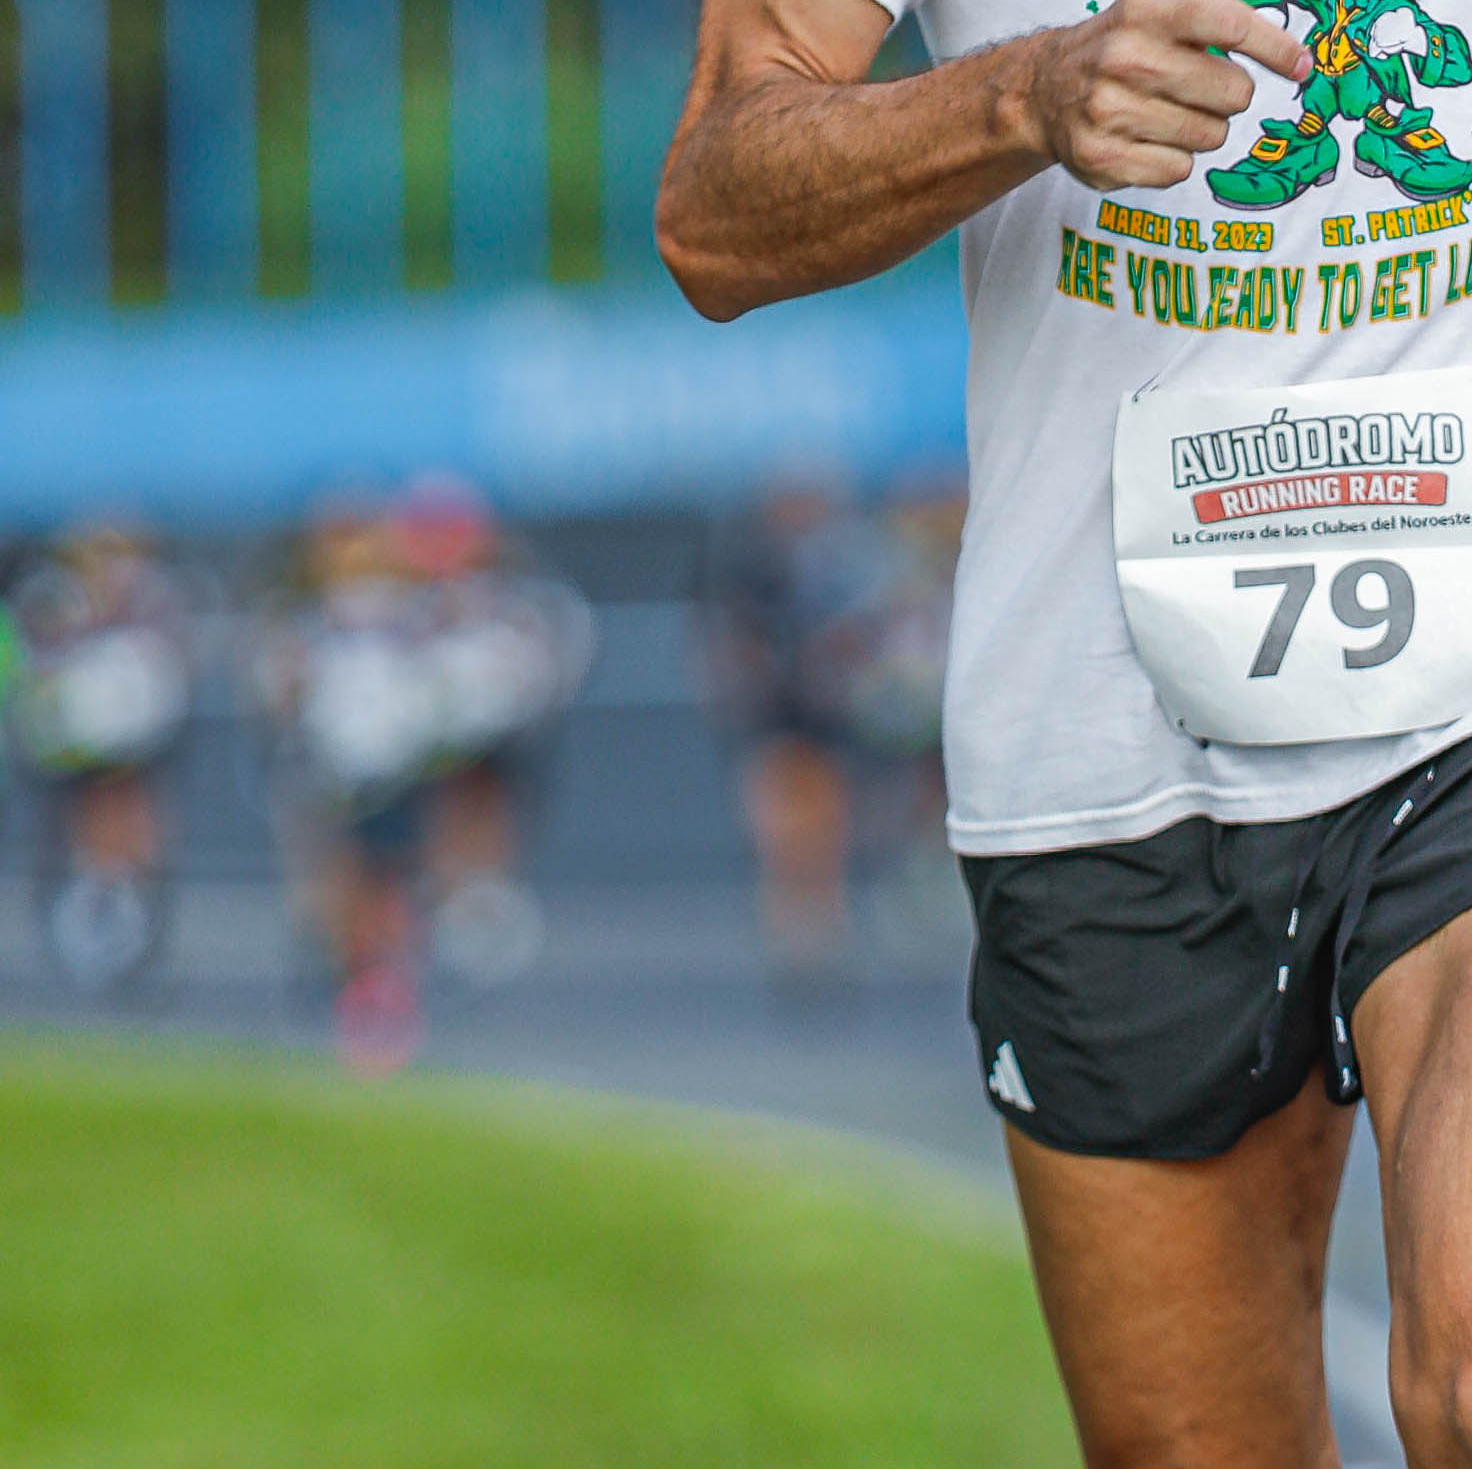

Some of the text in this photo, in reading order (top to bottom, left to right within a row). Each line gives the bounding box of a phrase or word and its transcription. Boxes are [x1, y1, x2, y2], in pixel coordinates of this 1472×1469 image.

[1097, 198, 1274, 253] MARCH 11, 2023
[1322, 214, 1365, 247] ST.
[1126, 249, 1198, 325] YOU
[1317, 260, 1362, 334] TO
[1368, 247, 1437, 323] GET
[1171, 407, 1464, 488] AUTÓDROMO
[1219, 473, 1419, 518] RUNNING RACE
[1172, 512, 1472, 545] La Carrera de los Clubes del Noroeste
[1233, 558, 1415, 678] 79
